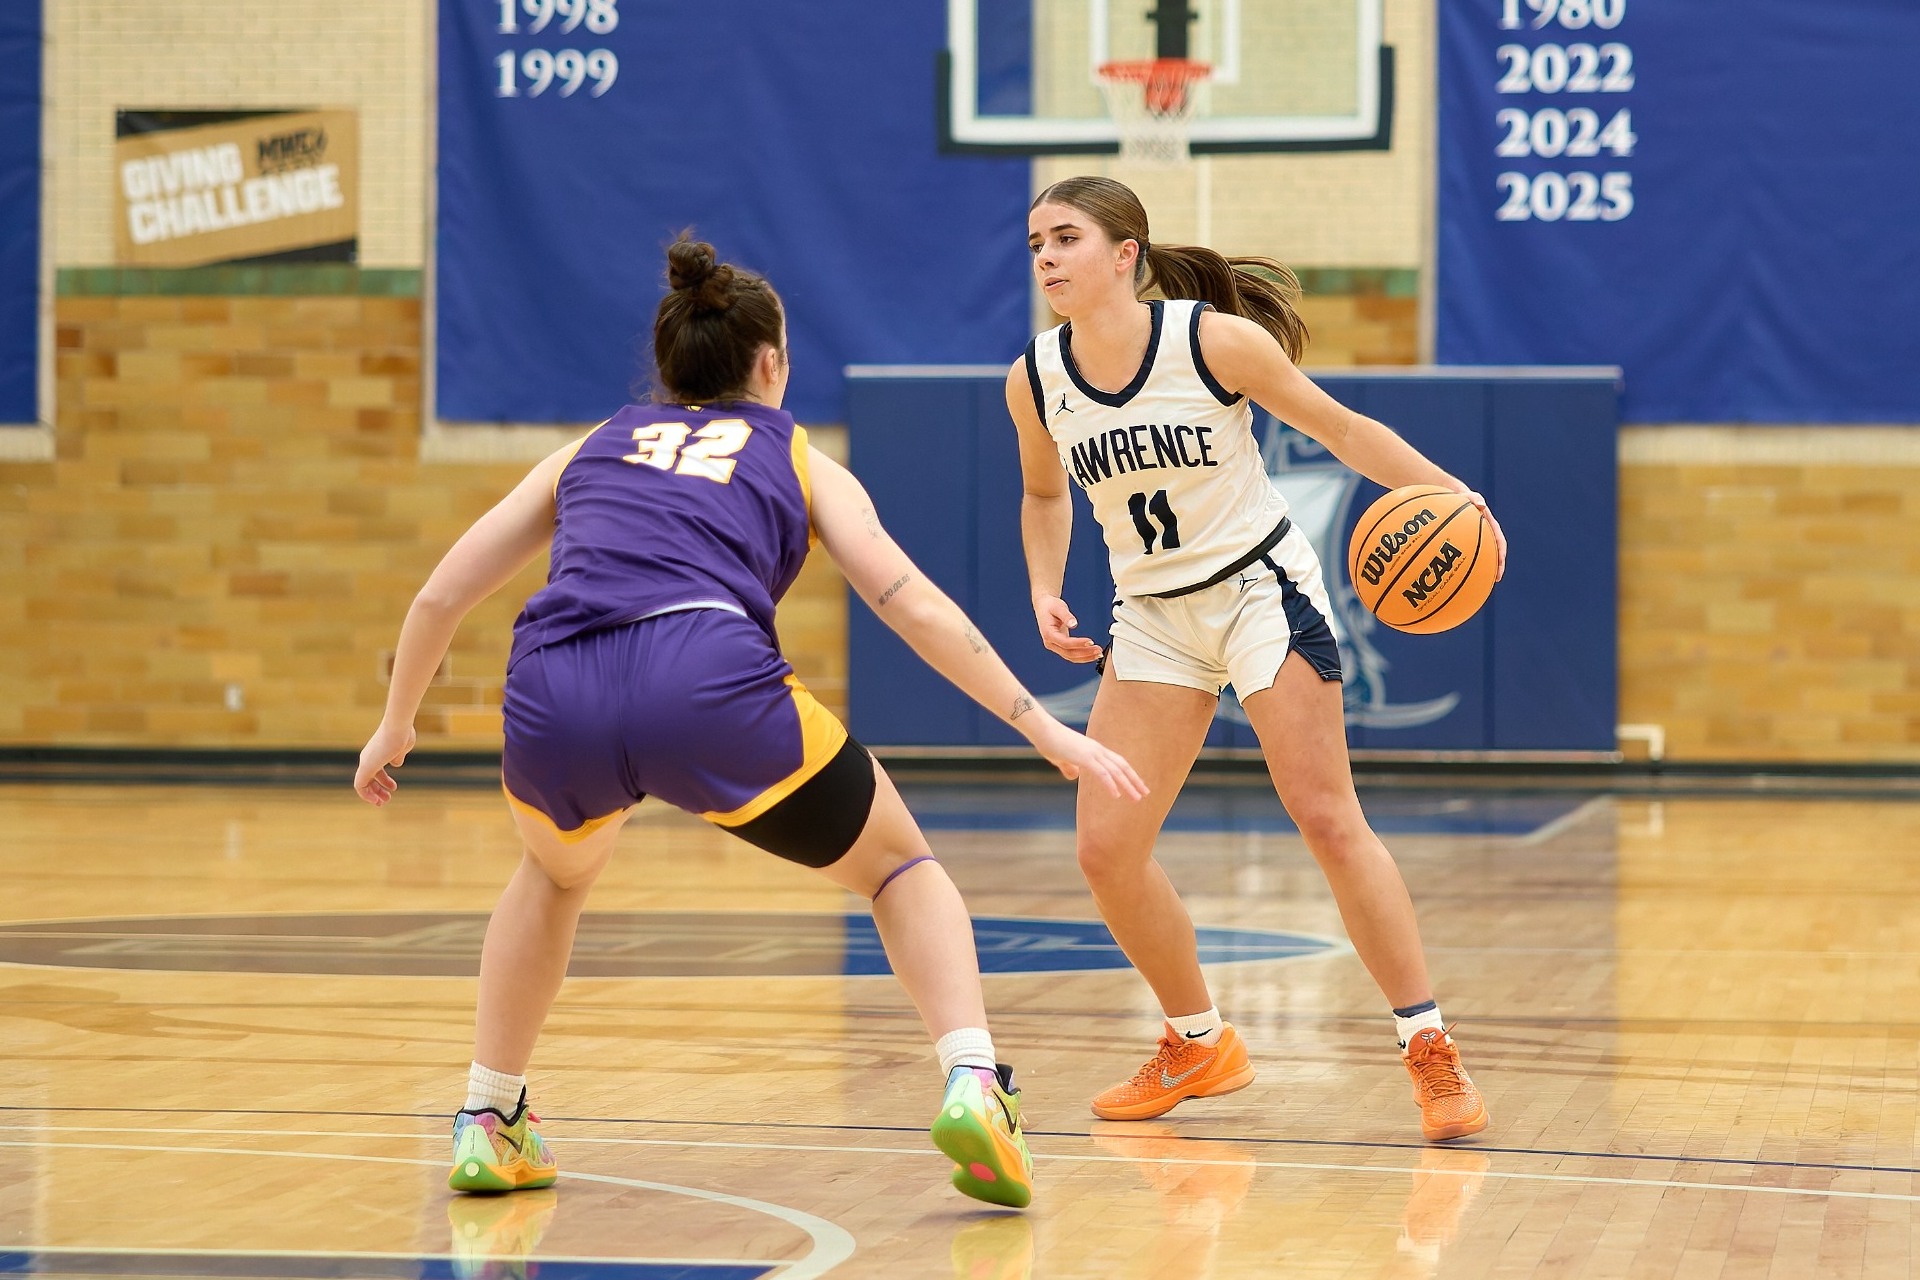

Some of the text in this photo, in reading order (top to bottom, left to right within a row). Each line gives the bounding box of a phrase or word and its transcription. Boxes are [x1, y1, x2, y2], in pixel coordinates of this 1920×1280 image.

[495, 0, 620, 35] 1998
[1497, 0, 1627, 30] 1980
[493, 48, 619, 98] 1999
[1495, 42, 1635, 94] 2022
[1494, 107, 1638, 158] 2024
[122, 142, 244, 200] GIVING
[1495, 171, 1635, 222] 2025
[128, 164, 344, 245] CHALLENGE
[622, 418, 753, 485] 32
[1062, 424, 1218, 488] AWRENCE
[1127, 489, 1181, 555] 11
[1361, 508, 1438, 586] Wilson
[1402, 541, 1463, 609] NCAA
